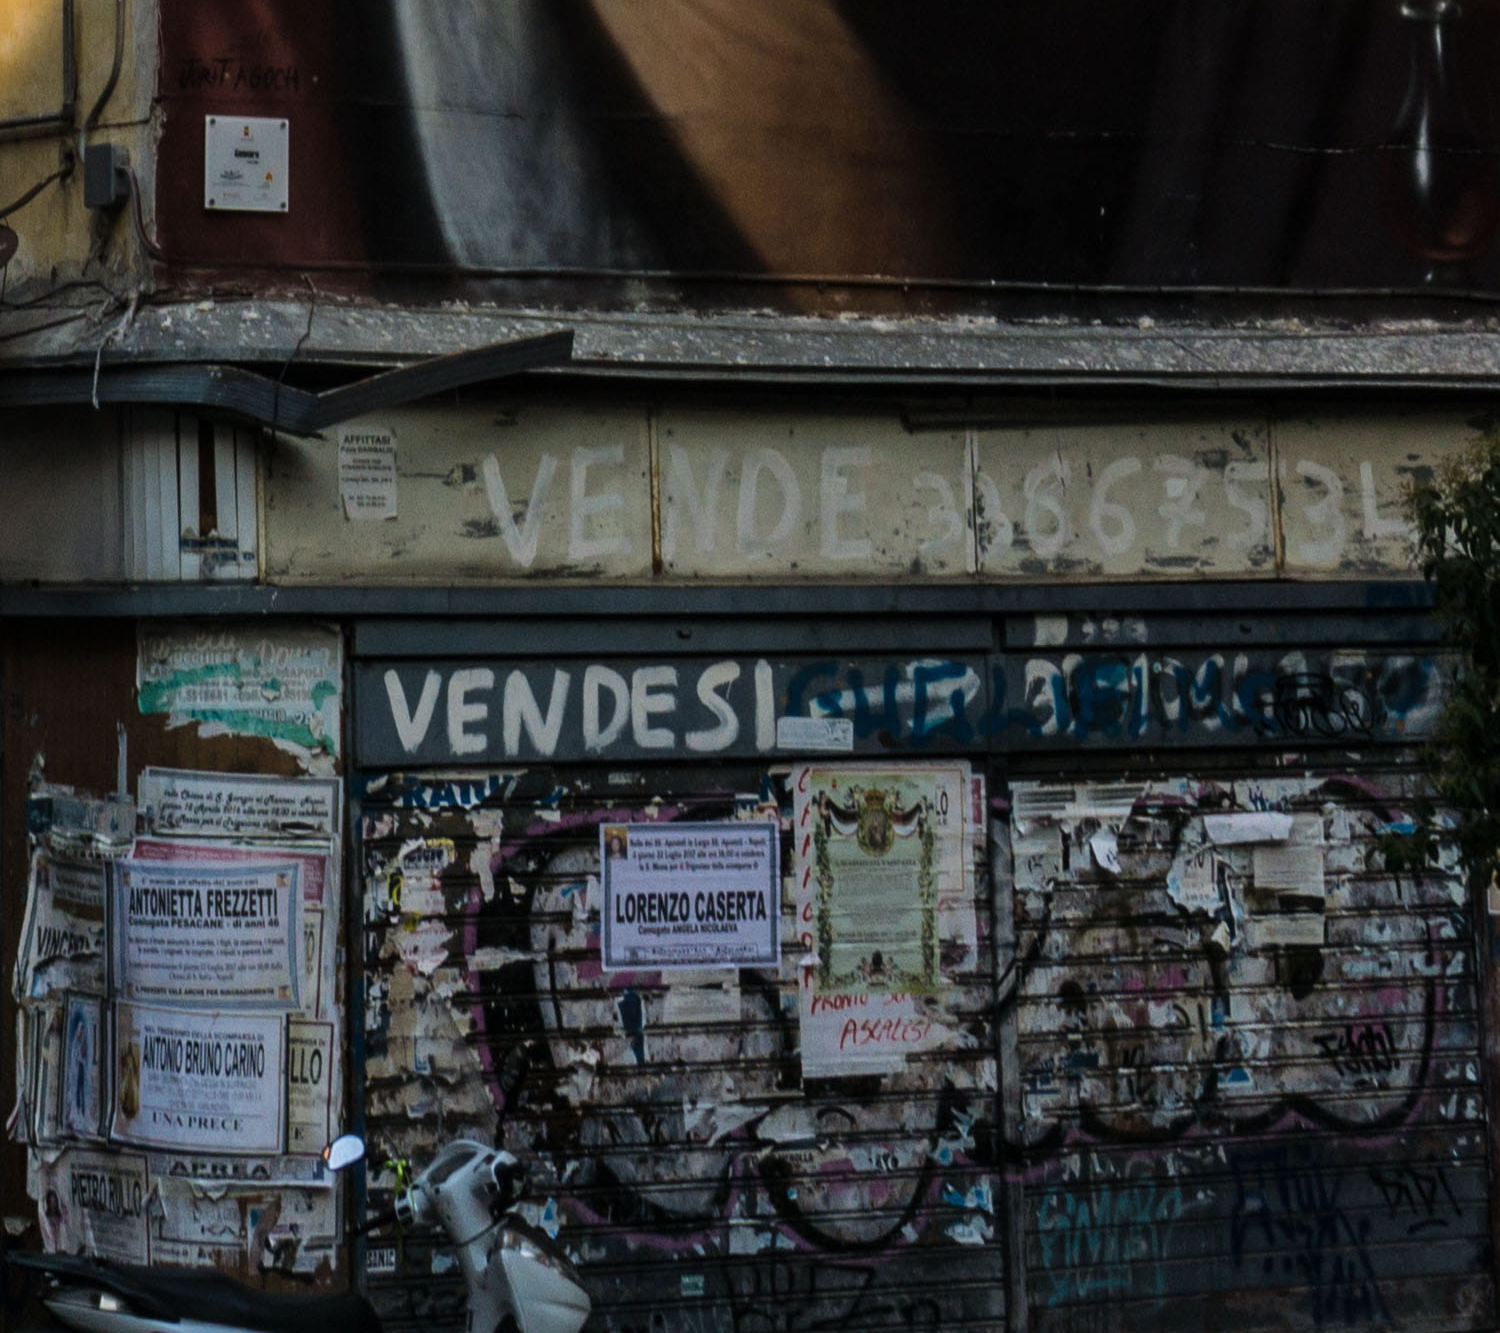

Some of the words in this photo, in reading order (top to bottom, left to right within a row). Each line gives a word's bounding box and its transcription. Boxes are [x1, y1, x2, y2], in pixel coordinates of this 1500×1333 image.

[383, 659, 775, 757] VENDESI
[129, 888, 203, 917] ANTONIETTA
[207, 889, 278, 917] FREZZETTI
[616, 892, 690, 923] LORENZO
[694, 890, 767, 923] CASERTA
[171, 918, 224, 929] PESACANE
[143, 1035, 183, 1073] ANTONIO
[185, 1038, 223, 1077] BRUNO
[224, 1041, 265, 1078] CARINO
[290, 1048, 323, 1085] LLO
[153, 1111, 183, 1127] UNA
[188, 1114, 244, 1131] PRECE
